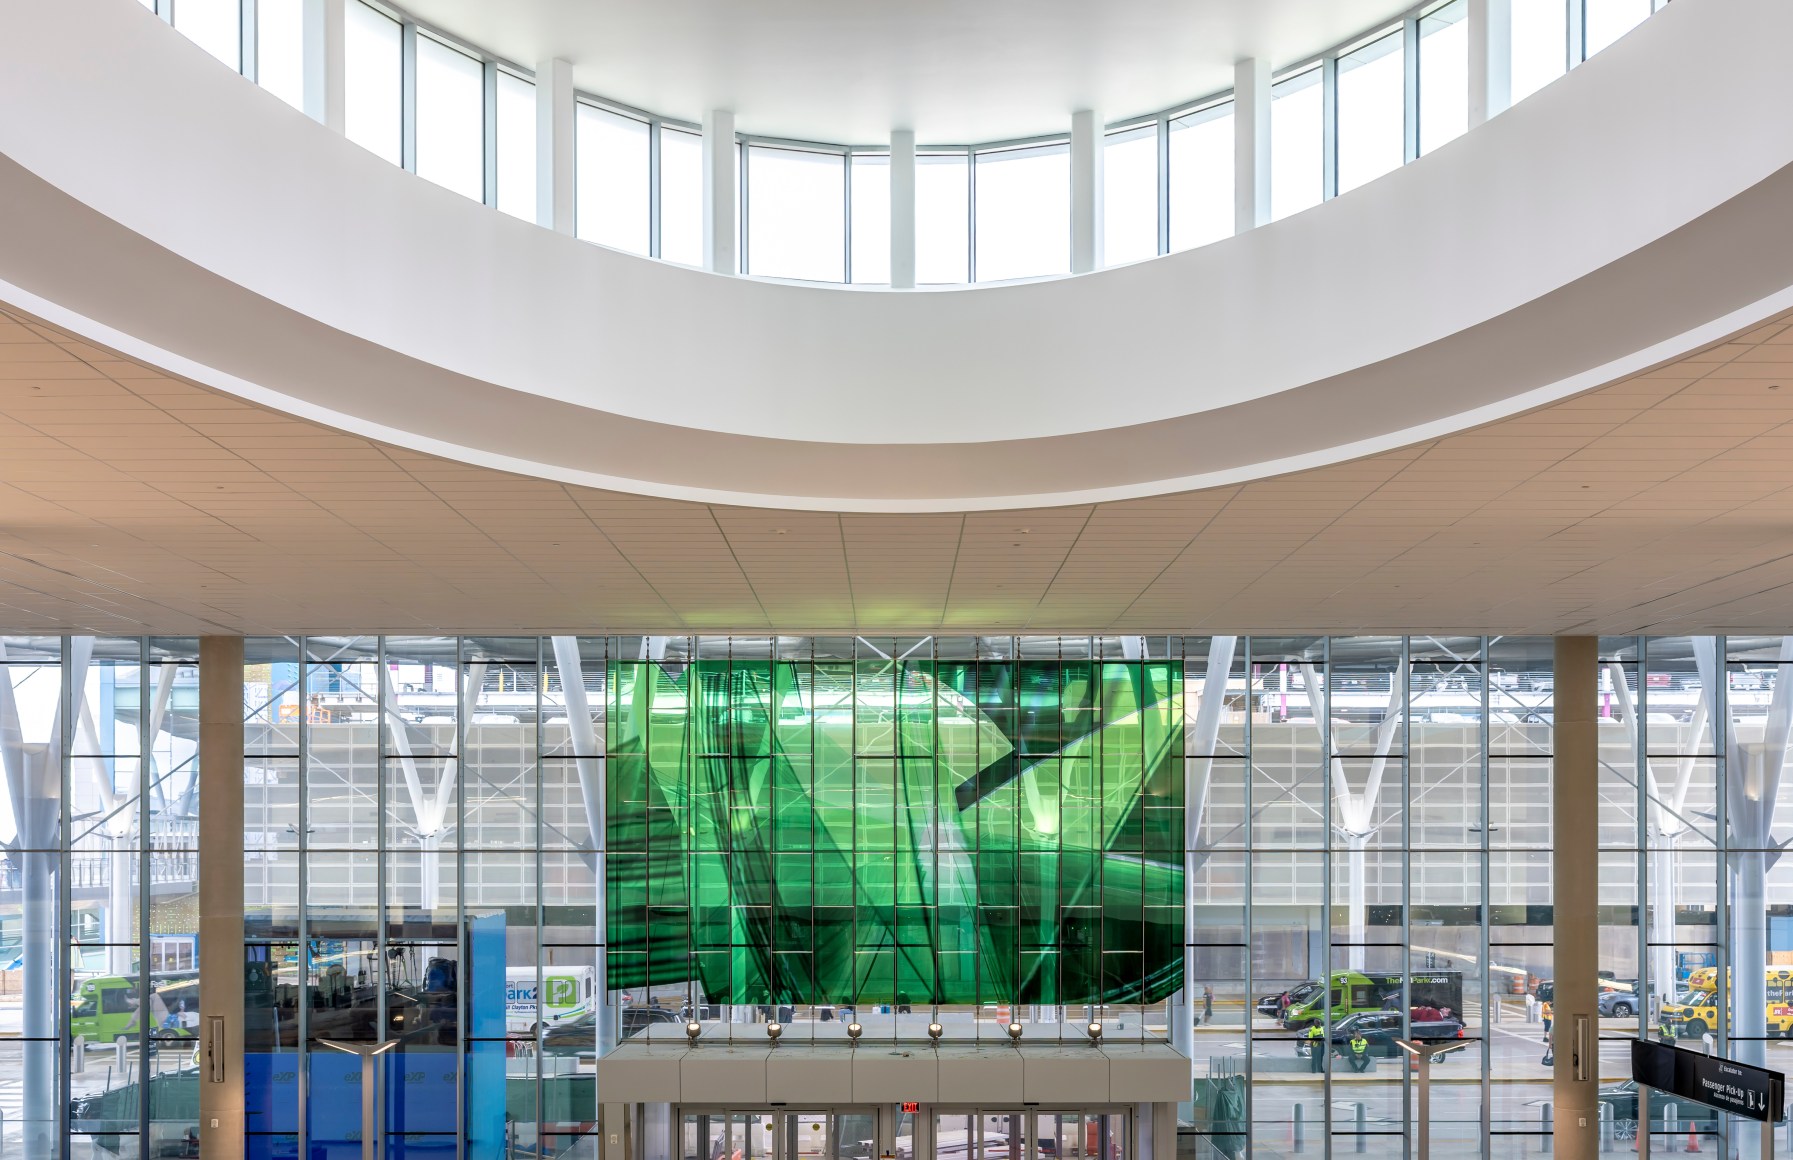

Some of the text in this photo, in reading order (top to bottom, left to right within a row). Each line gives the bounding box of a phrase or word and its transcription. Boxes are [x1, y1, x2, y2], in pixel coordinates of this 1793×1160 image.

[1702, 1078, 1744, 1100] Passenger Pick-Up
[903, 1102, 918, 1113] EXIT
